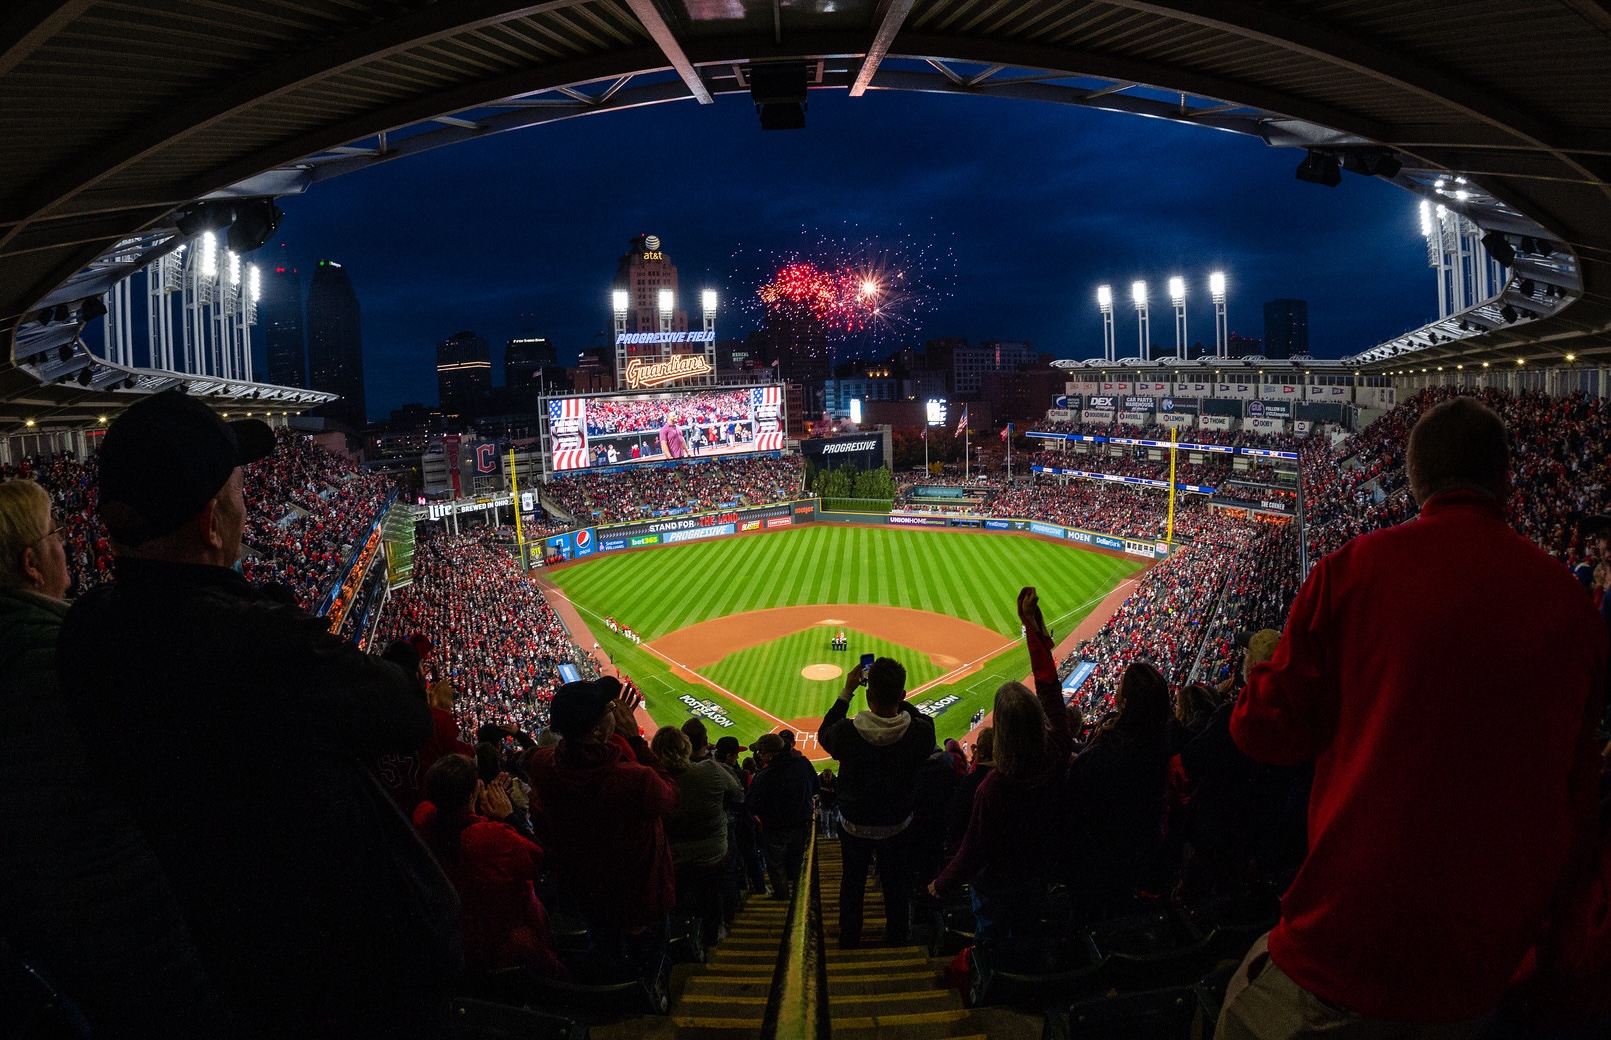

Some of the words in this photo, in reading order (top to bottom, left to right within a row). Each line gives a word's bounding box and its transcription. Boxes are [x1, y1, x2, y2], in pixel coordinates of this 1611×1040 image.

[644, 251, 662, 260] at&t
[616, 332, 686, 344] PROGRESSIVE
[686, 331, 716, 342] FIELD
[626, 355, 711, 388] Guardians
[1090, 398, 1113, 406] DEX
[822, 441, 876, 454] PROGRESSIVE
[461, 503, 486, 512] BREWED
[495, 499, 509, 507] OHIO
[794, 506, 814, 514] meijer
[1269, 502, 1285, 510] CORNER
[428, 505, 452, 521] Lite
[650, 523, 677, 532] STAND
[678, 520, 695, 529] FOR
[700, 516, 715, 526] THE
[718, 513, 738, 524] LAND
[669, 525, 727, 542] PROGRESSIVE
[1032, 524, 1062, 535] PROGRESSIVE
[632, 536, 658, 546] bet365
[1068, 531, 1091, 542] MOEN
[1096, 537, 1121, 548] DollarBank
[579, 548, 591, 556] pepsi
[679, 695, 734, 727] POSTSEASON
[920, 695, 959, 715] SEASON
